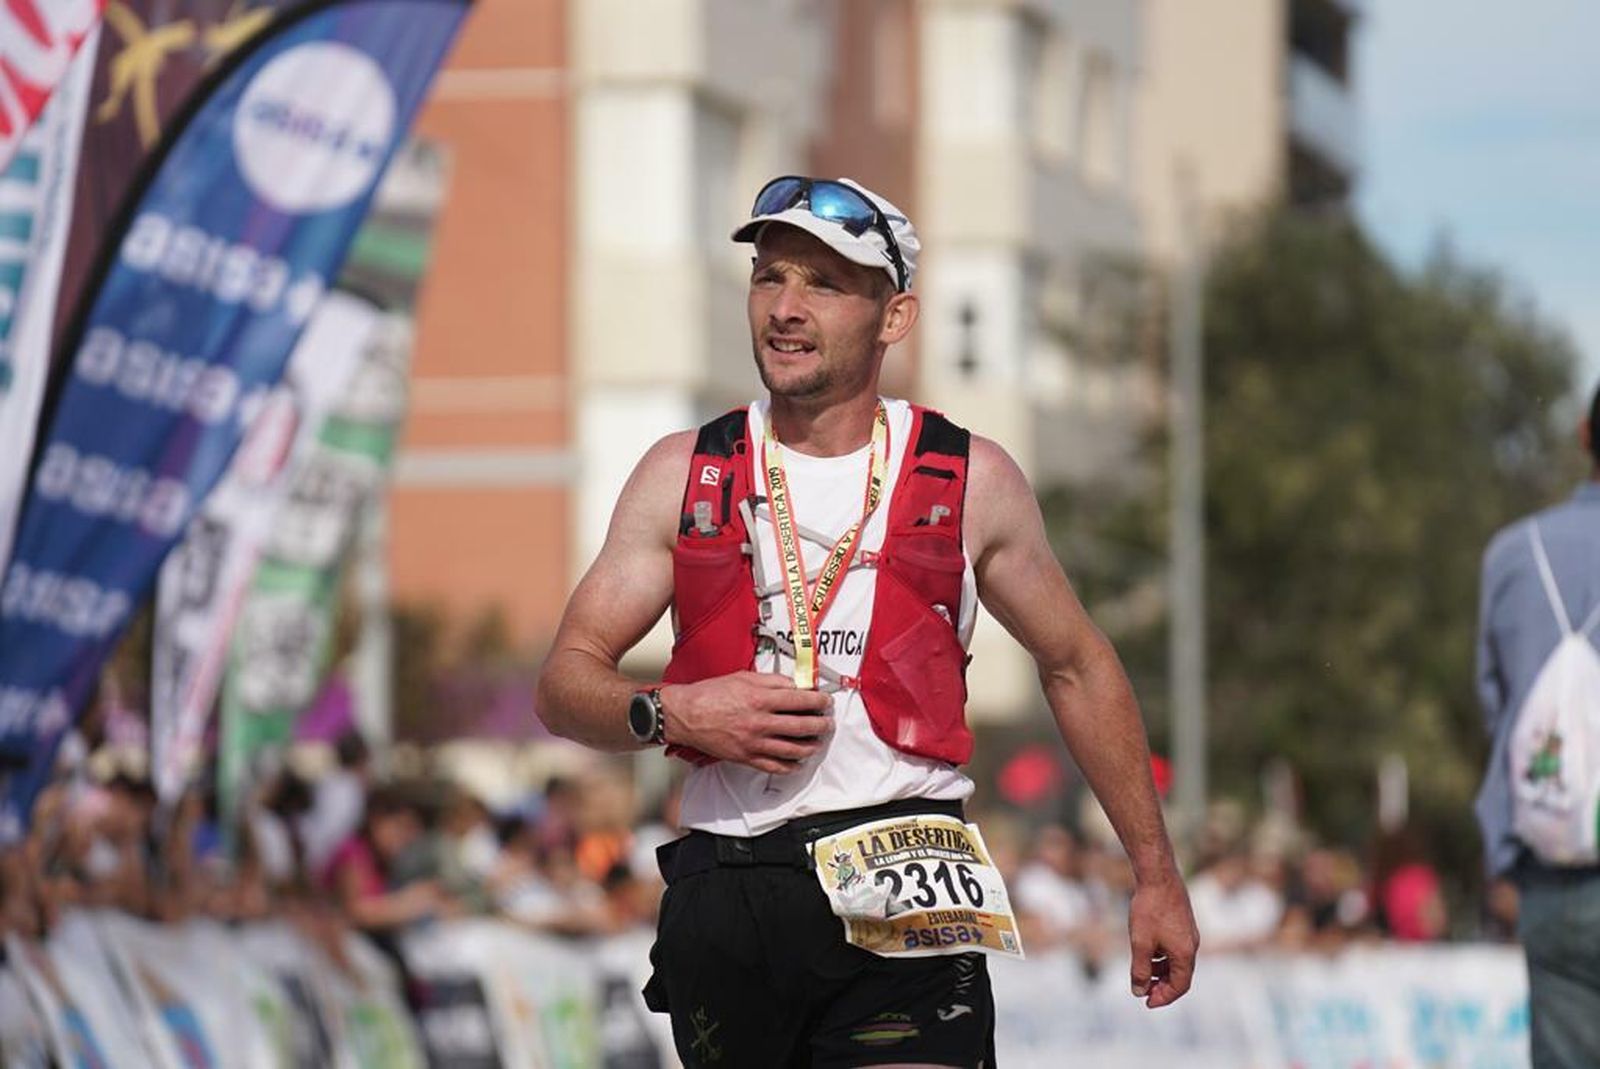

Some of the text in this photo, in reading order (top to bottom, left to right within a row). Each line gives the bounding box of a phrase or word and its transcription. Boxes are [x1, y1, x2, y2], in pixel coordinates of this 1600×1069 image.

[768, 466, 783, 491] 2019
[774, 493, 797, 563] DESERTICA
[788, 564, 799, 583] LA
[812, 546, 847, 612] DESERTICA
[857, 835, 888, 857] LA
[874, 860, 984, 918] 2316
